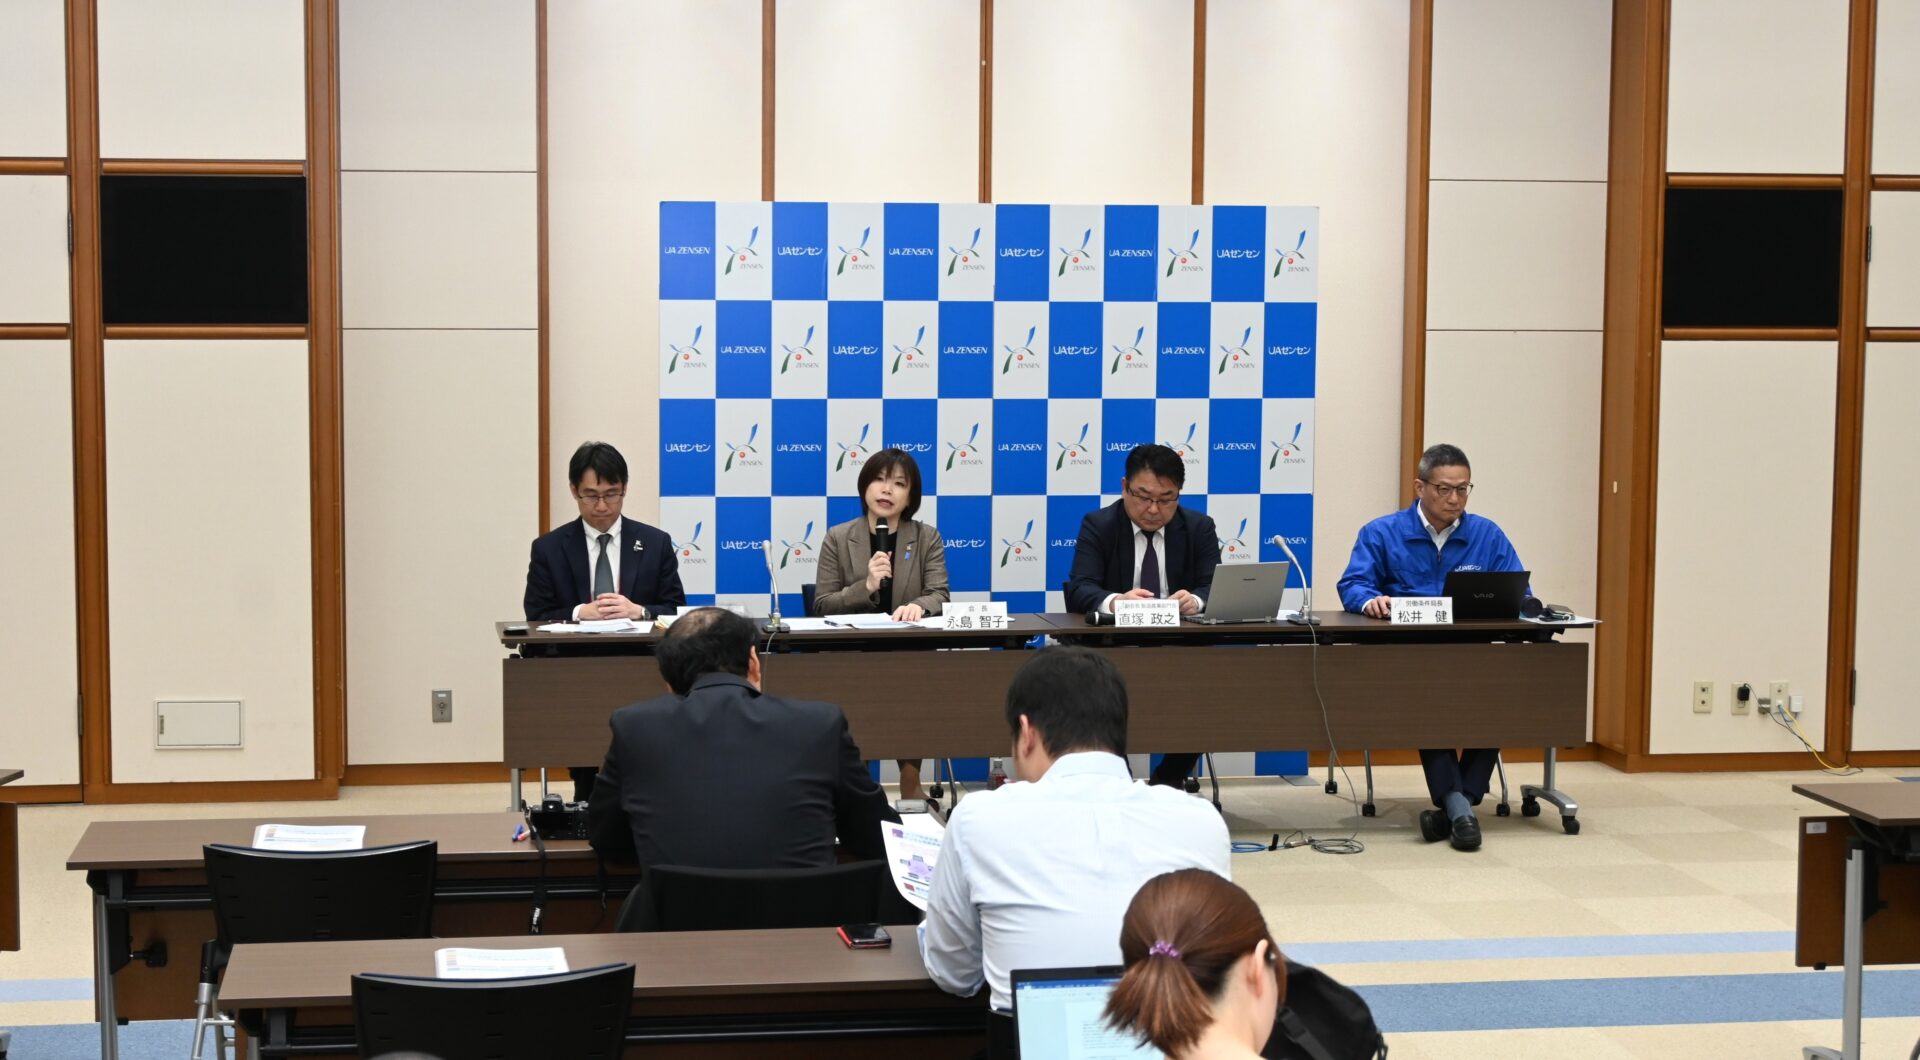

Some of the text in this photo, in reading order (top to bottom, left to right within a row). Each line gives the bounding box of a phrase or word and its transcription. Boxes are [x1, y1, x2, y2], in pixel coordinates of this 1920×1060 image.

[664, 246, 711, 255] UA ZENSEN
[777, 246, 823, 256] UAゼンセン
[888, 247, 934, 256] UA ZENSEN
[999, 247, 1045, 258] UAゼンセン
[1108, 249, 1153, 257] UA ZENSEN
[1216, 249, 1261, 259] UAゼンセン
[720, 345, 767, 354] UA ZENSEN
[832, 345, 879, 355] UAゼンセン
[943, 346, 988, 354] UA ZENSEN
[1053, 345, 1098, 356] UAゼンセン
[1161, 346, 1206, 355] UA ZENSEN
[1268, 346, 1311, 356] UAゼンセン
[664, 443, 711, 453] UAゼンセン
[776, 443, 822, 452] UA ZENSEN
[997, 443, 1042, 452] UA ZENSEN
[1106, 442, 1145, 452] UAゼン
[1213, 442, 1257, 451] UA ZENSEN
[1050, 538, 1077, 547] UA ZEN
[1150, 612, 1176, 626] 政之
[1397, 609, 1448, 623] 松井 健
[978, 615, 1005, 629] 智子
